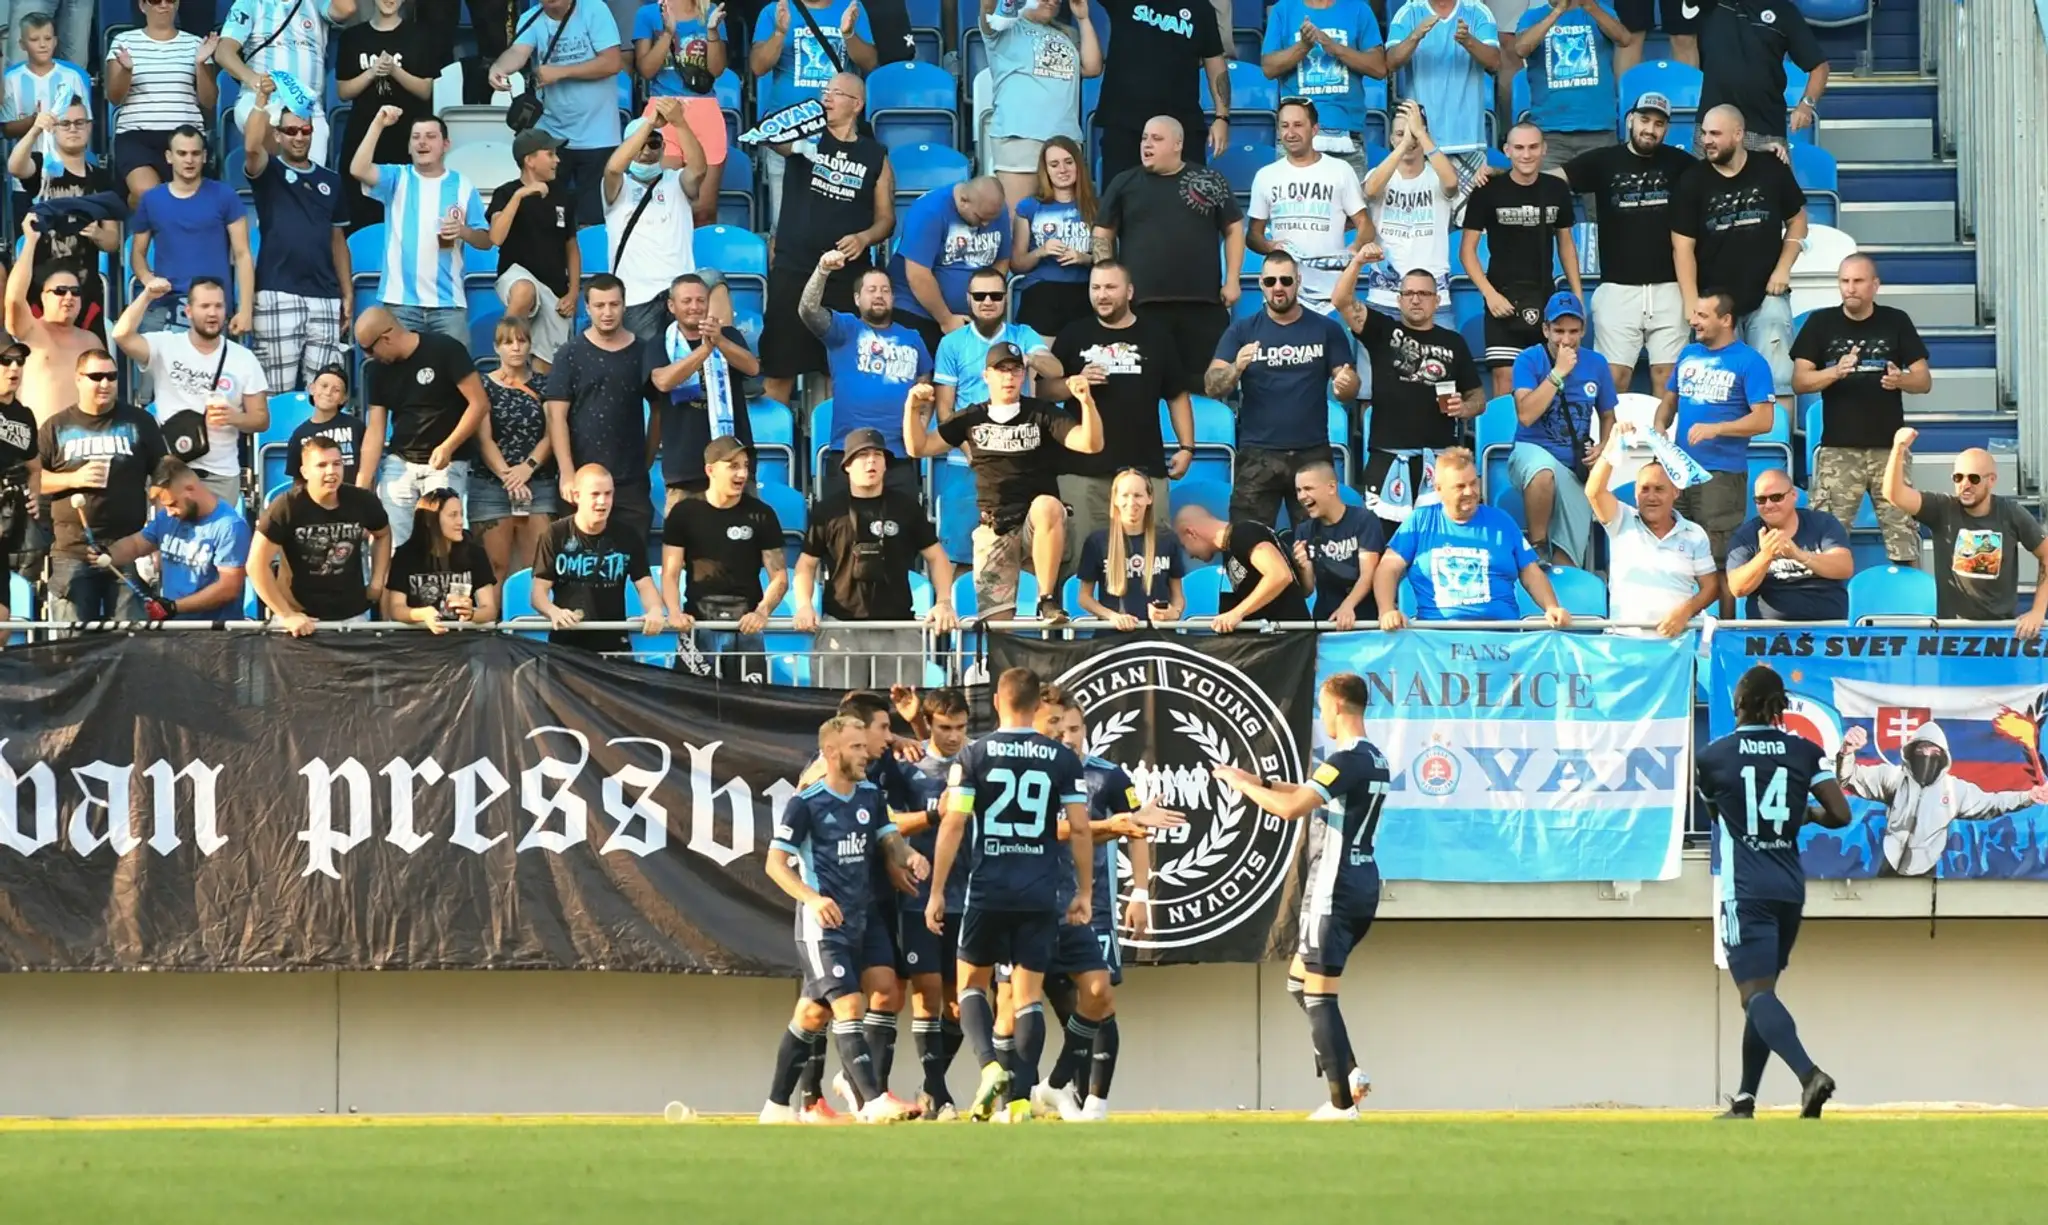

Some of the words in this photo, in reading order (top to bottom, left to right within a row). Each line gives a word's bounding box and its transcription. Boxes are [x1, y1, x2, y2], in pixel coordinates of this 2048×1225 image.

[815, 153, 867, 178] SLOVAN
[1271, 182, 1333, 203] SLOVAN
[1311, 222, 1330, 231] CLUB
[1267, 359, 1283, 367] ON
[64, 435, 134, 461] PITBULL
[1451, 643, 1511, 661] FANS
[1745, 633, 1814, 657] NÁŠ
[1825, 636, 1907, 657] SVET
[1917, 636, 2048, 658] NEZNIČ
[1366, 671, 1595, 709] NADLICE
[1181, 669, 1262, 737] YOUNG
[1739, 739, 1786, 754] Abena
[984, 768, 1051, 838] 29
[1741, 766, 1790, 836] 14
[1168, 850, 1267, 924] SLOVAN
